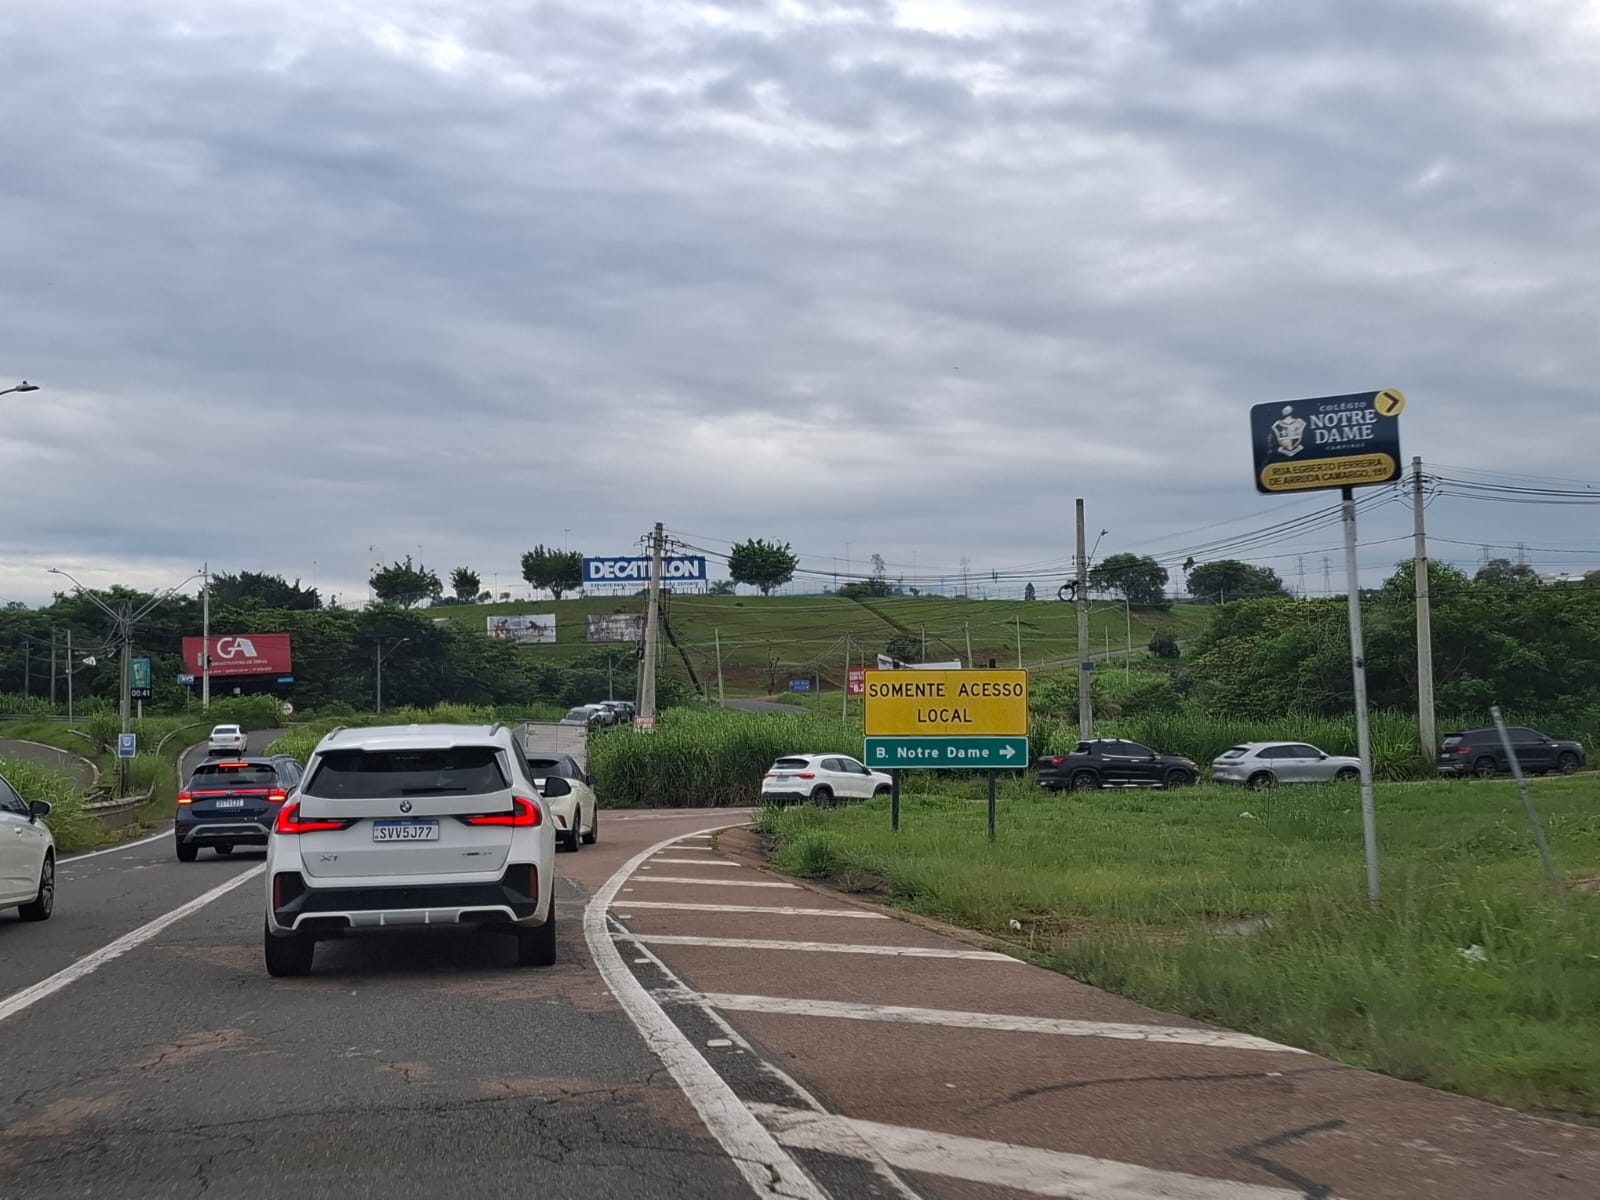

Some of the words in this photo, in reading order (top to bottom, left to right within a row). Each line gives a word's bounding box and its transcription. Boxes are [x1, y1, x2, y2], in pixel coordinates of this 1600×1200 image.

[1309, 408, 1377, 429] NOTRE
[1315, 424, 1374, 444] DAME
[1272, 467, 1291, 475] RUA
[1337, 458, 1383, 470] FERREIRA
[1269, 477, 1283, 487] DE
[1284, 474, 1321, 485] ARRUDA
[869, 683, 945, 697] SOMENTE
[958, 683, 1023, 697] ACESSO
[917, 709, 973, 723] LOCAL
[876, 747, 889, 758] B.
[897, 747, 939, 758] Notre
[947, 747, 990, 758] Dame
[379, 827, 433, 839] SVV5J77
